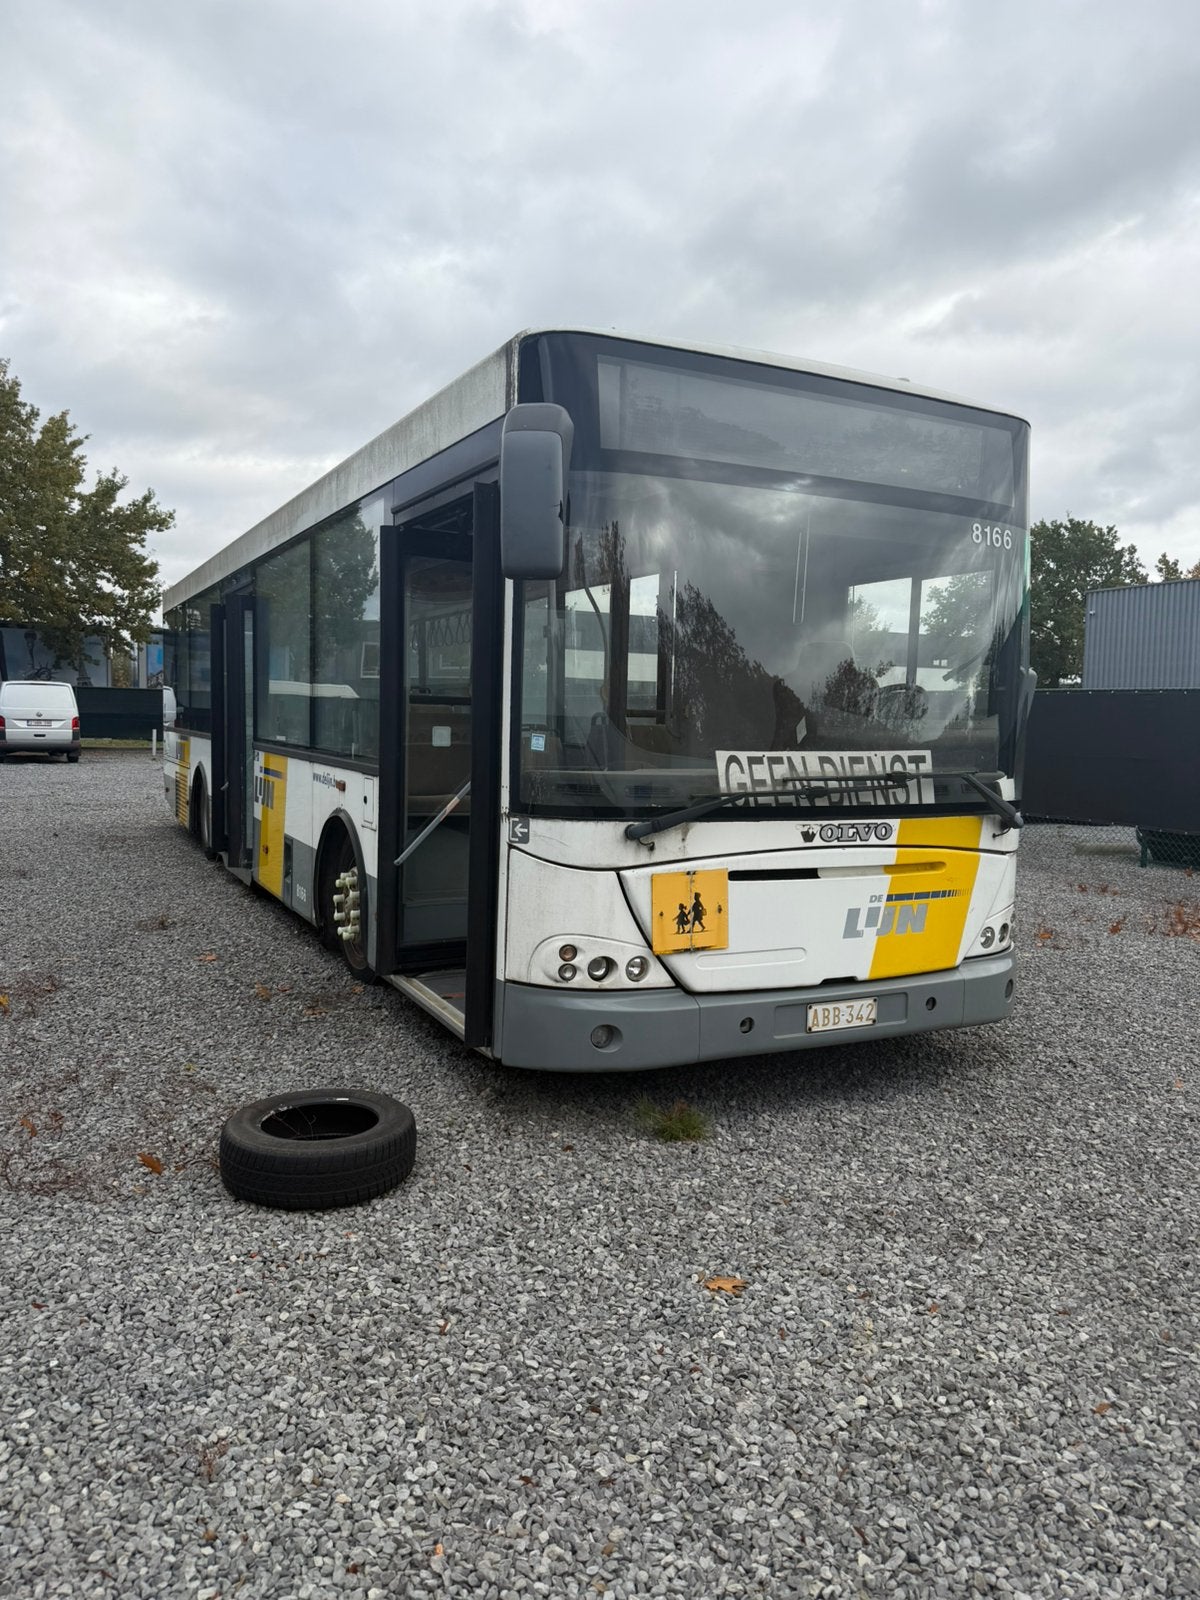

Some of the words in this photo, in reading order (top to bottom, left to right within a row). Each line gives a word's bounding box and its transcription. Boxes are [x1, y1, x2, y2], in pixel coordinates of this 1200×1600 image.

[972, 523, 1012, 549] 8166
[725, 755, 812, 807] GEEN
[818, 754, 927, 805] DIENST
[795, 822, 894, 843] VOLVO
[869, 894, 884, 903] DE
[811, 1002, 875, 1028] ABB-342
